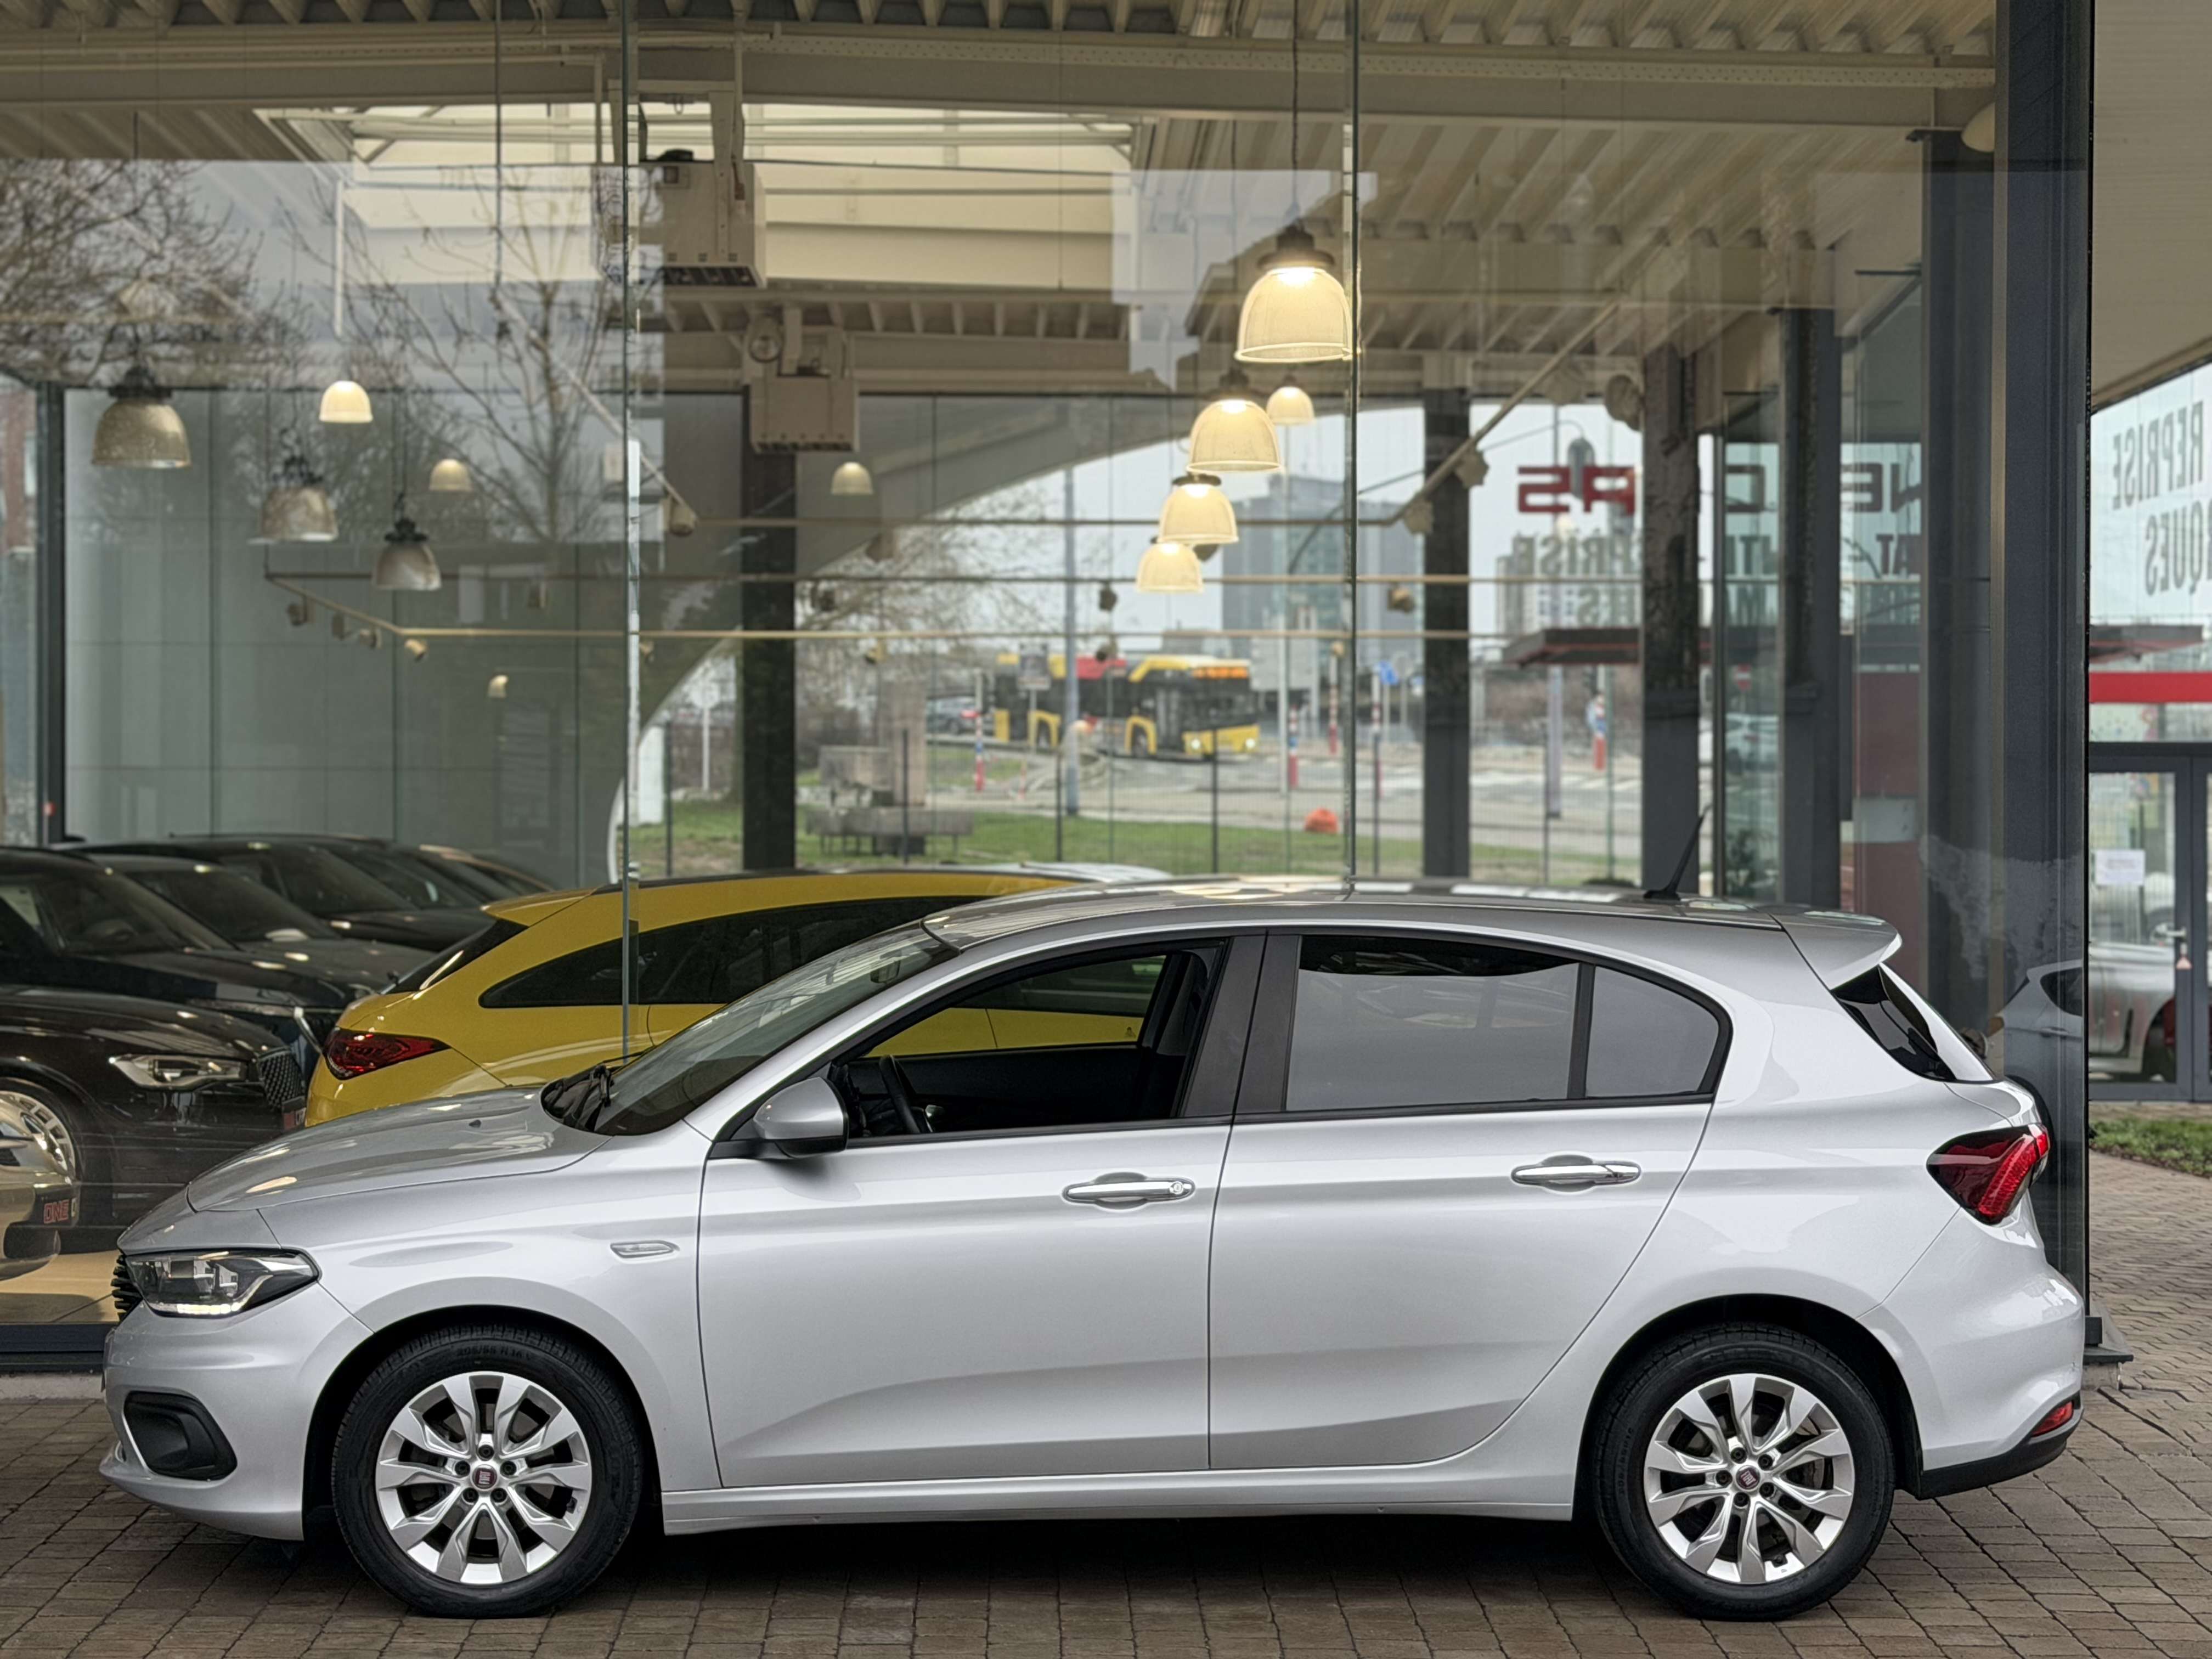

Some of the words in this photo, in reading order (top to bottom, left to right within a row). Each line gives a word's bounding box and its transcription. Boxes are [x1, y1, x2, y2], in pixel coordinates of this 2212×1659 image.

[44, 1200, 69, 1223] ONE
[478, 1470, 492, 1485] FIAT
[1740, 1470, 1757, 1486] FIAT
